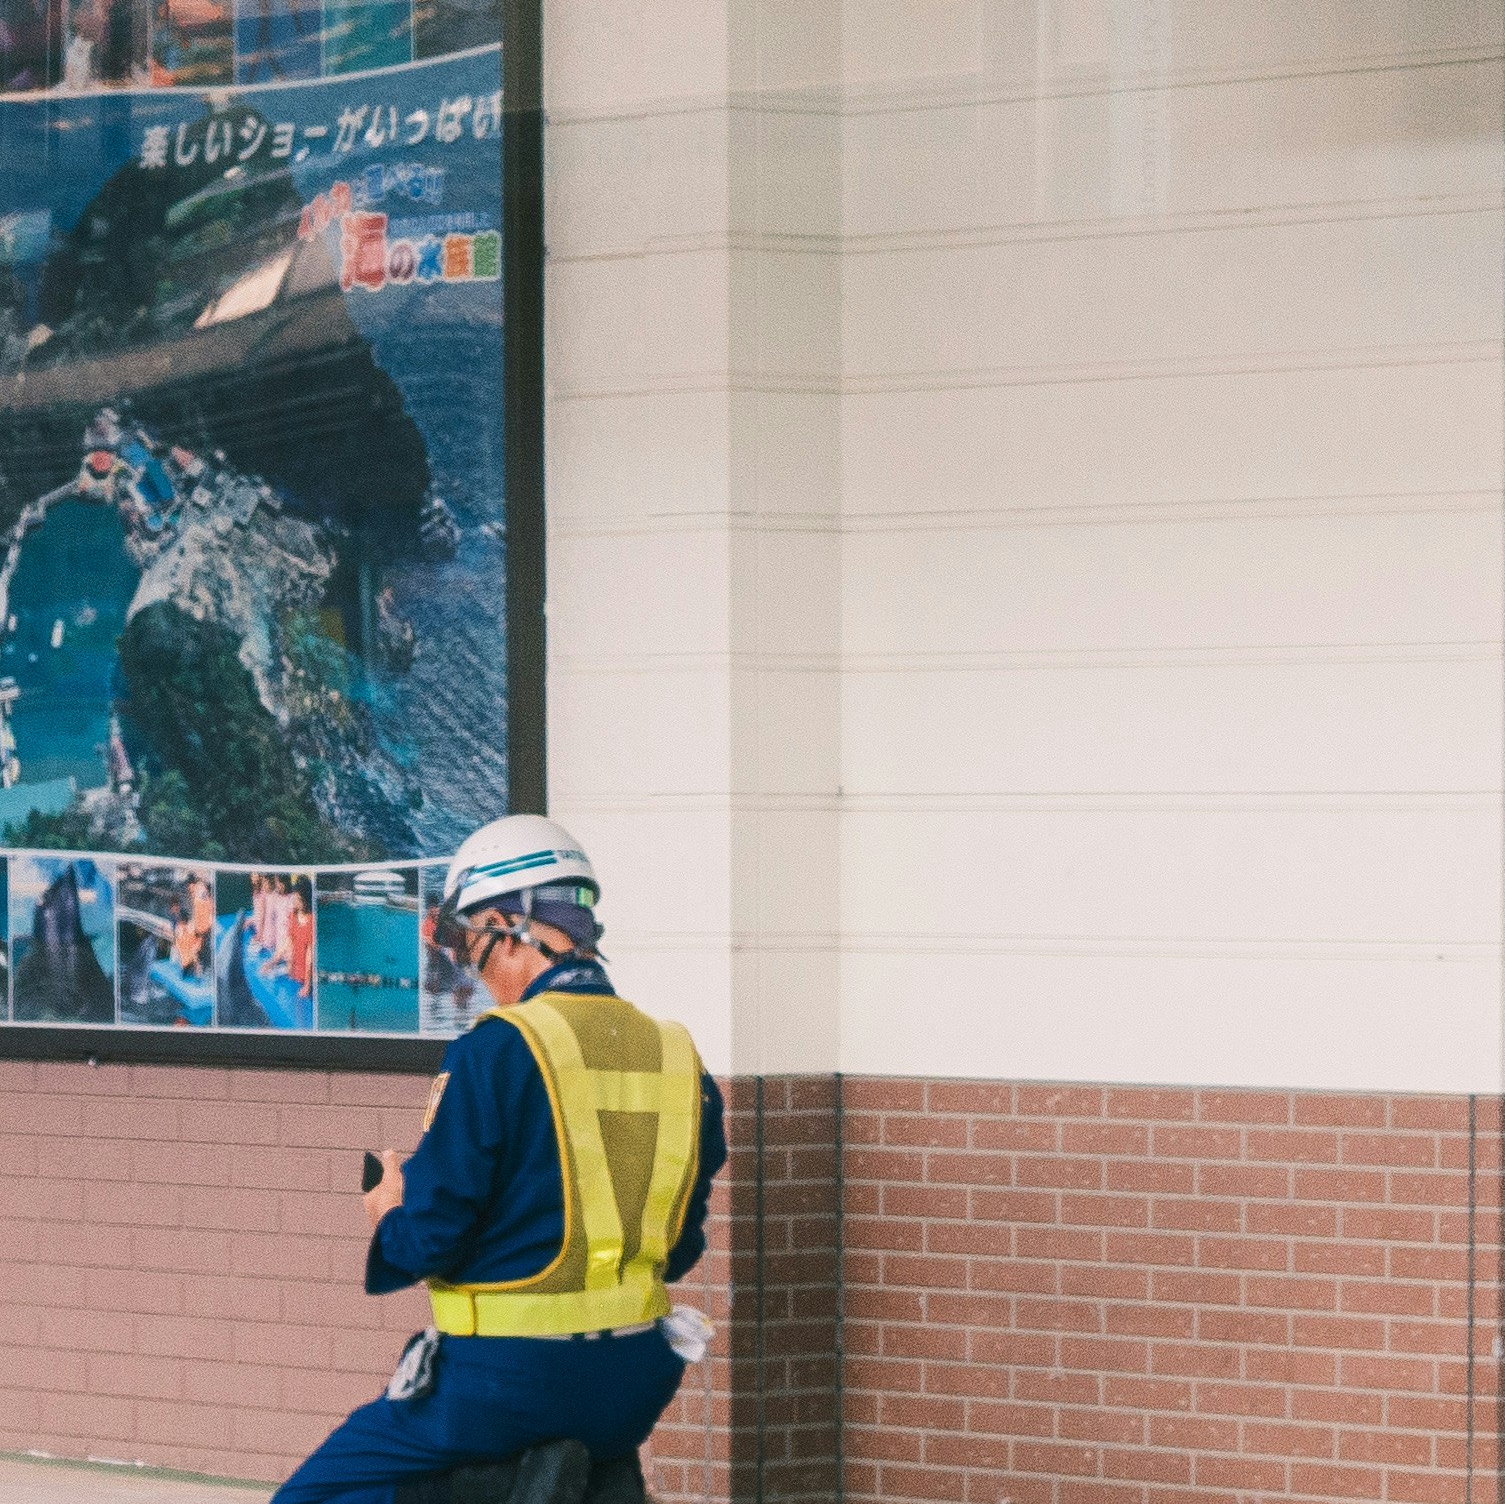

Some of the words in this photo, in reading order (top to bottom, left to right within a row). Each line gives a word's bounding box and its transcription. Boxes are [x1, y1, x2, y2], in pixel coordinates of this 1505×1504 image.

[139, 89, 502, 171] 楽しいショーがいっぱい
